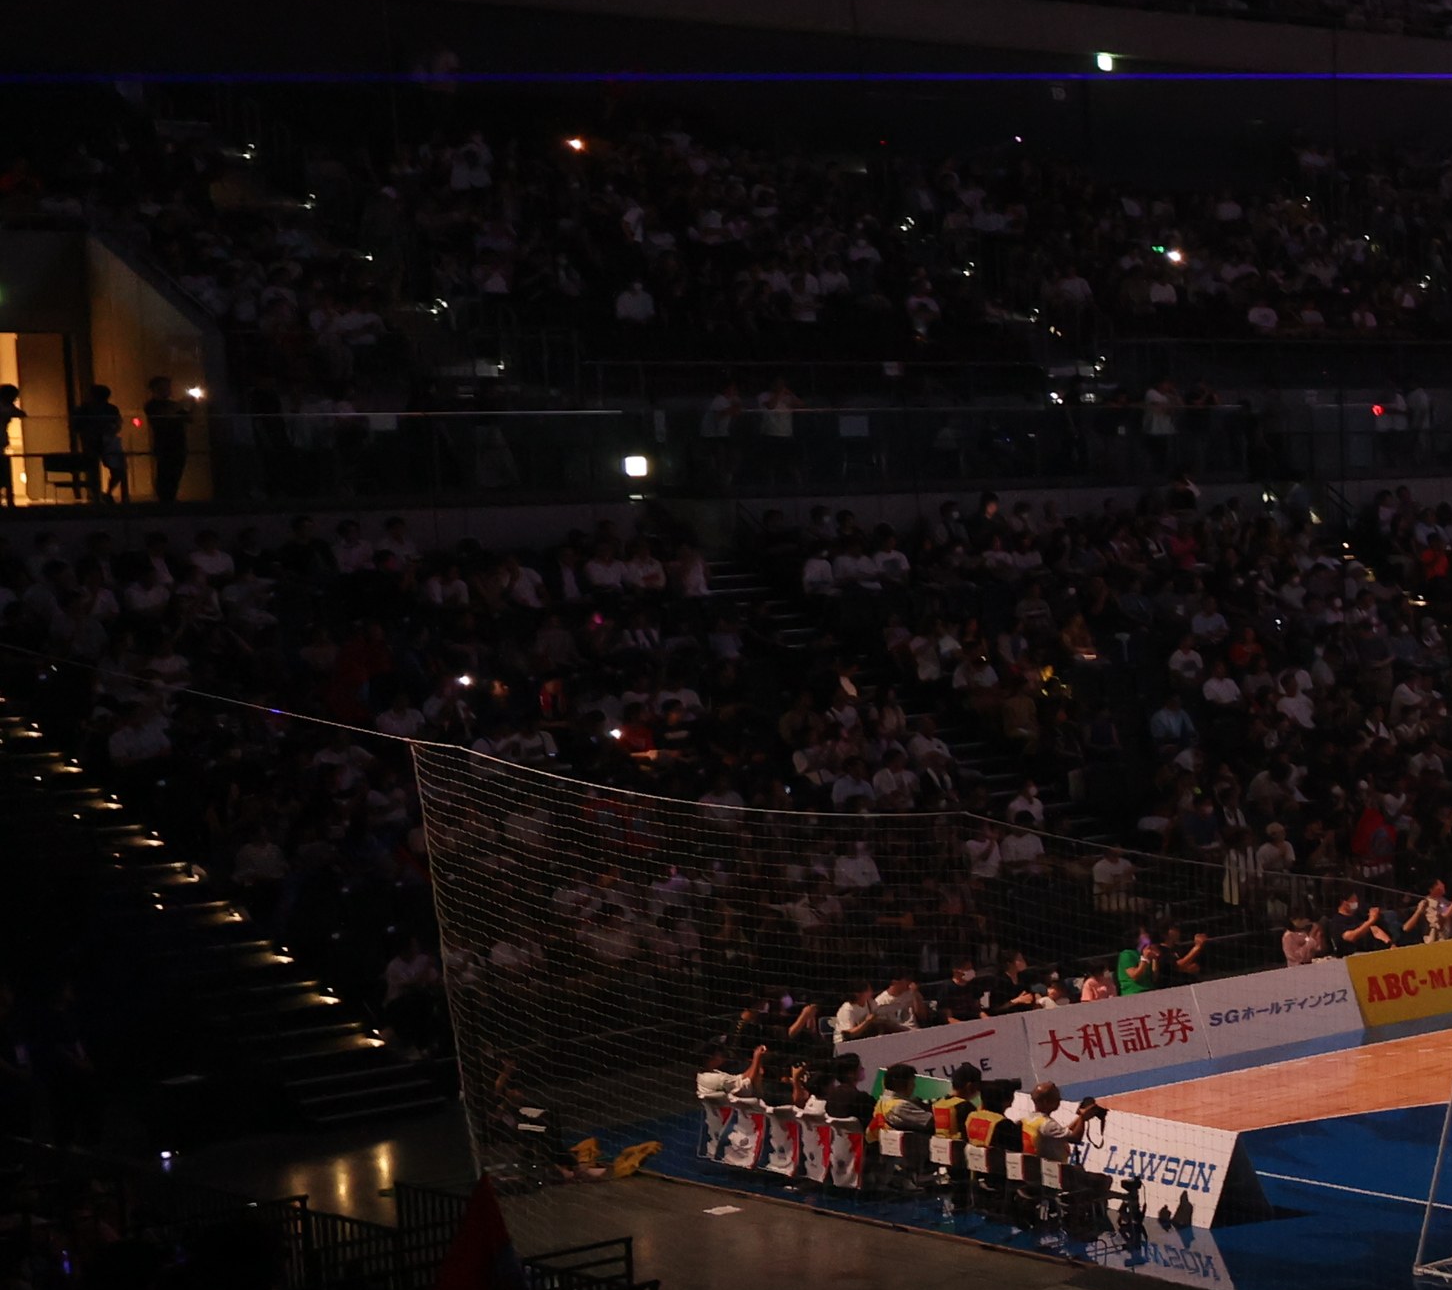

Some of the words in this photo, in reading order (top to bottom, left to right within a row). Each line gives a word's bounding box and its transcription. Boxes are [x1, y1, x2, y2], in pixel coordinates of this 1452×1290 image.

[1208, 988, 1350, 1028] SGホールディングス
[1038, 1007, 1195, 1069] 大和証券
[1103, 1145, 1217, 1193] LAWSON
